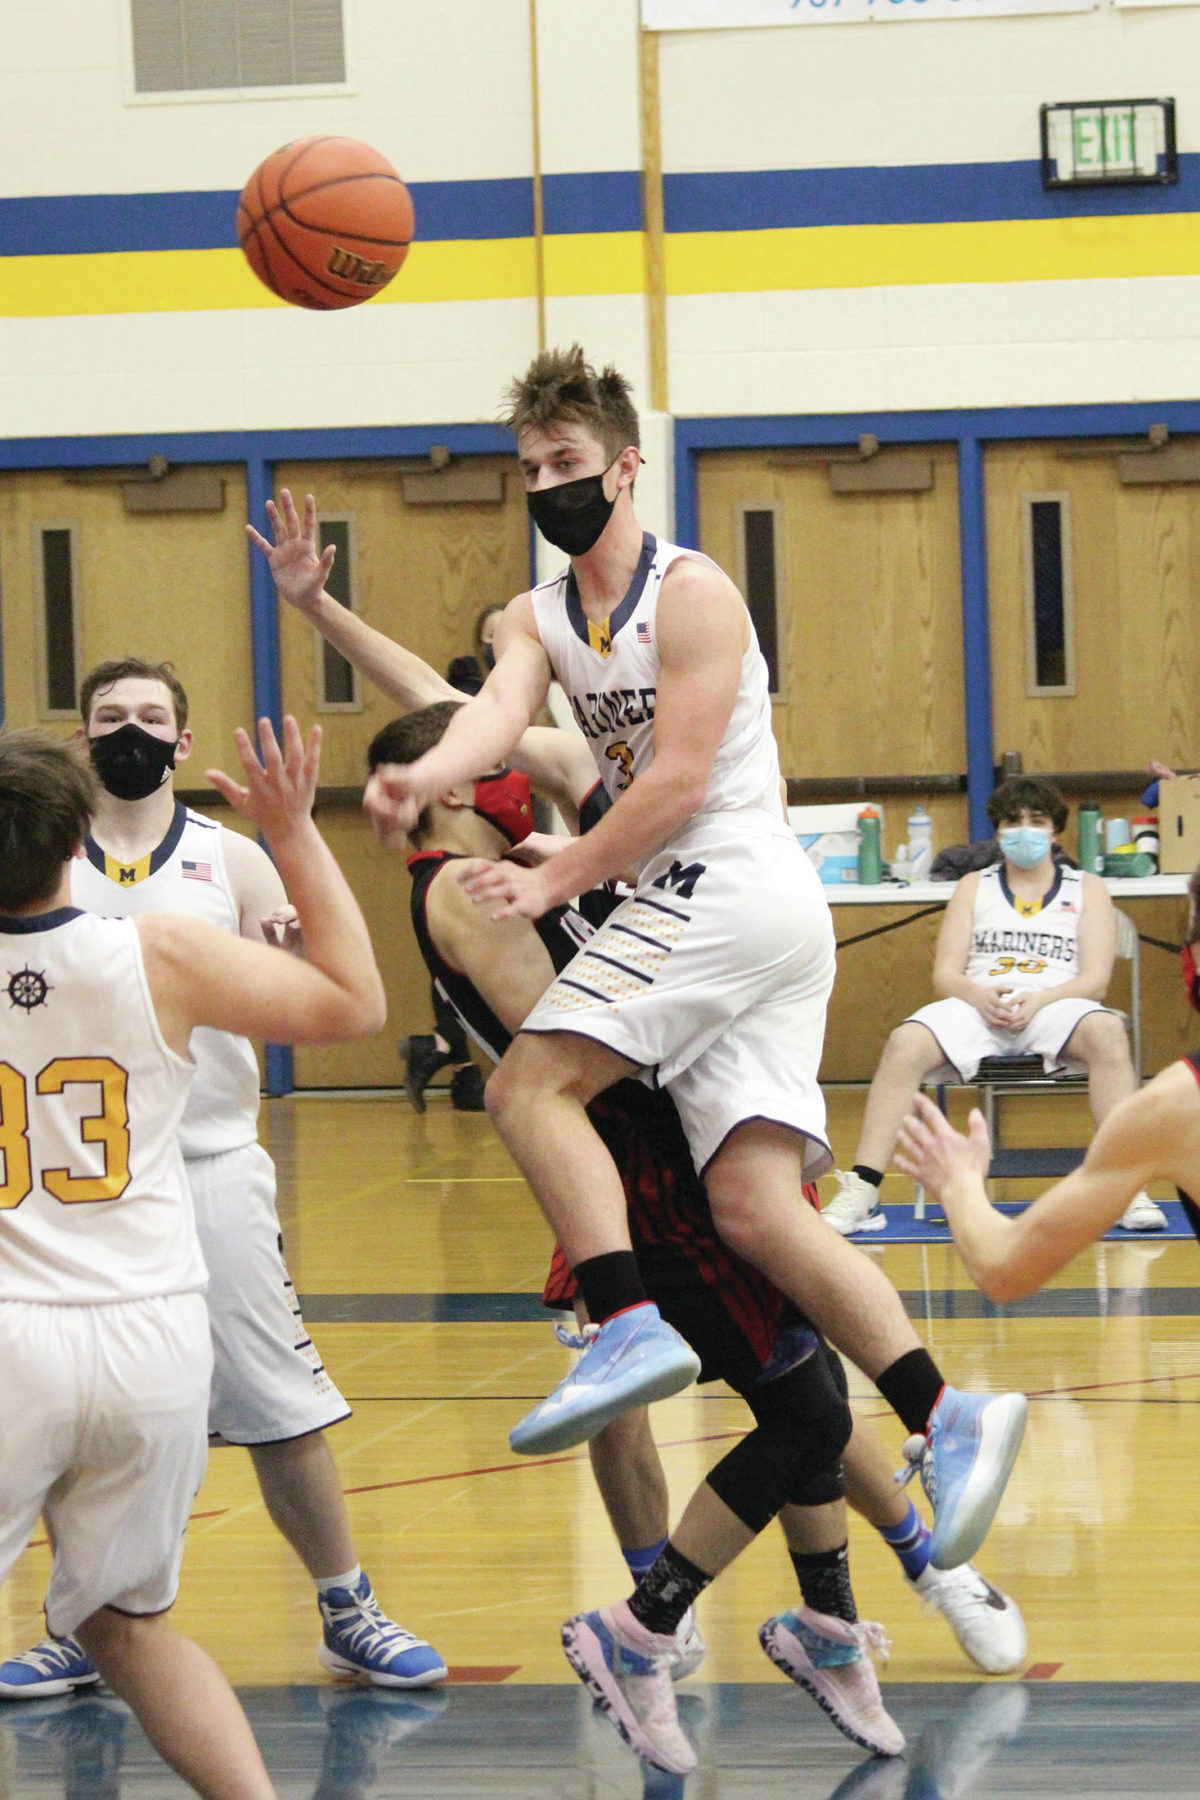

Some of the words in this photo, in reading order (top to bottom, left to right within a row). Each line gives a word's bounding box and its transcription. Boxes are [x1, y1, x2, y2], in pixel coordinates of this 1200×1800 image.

[1076, 114, 1136, 163] EXIT
[600, 636, 612, 652] M
[569, 687, 656, 739] ARINER
[119, 868, 136, 882] M
[651, 860, 707, 900] M
[974, 930, 1075, 962] MARINERS
